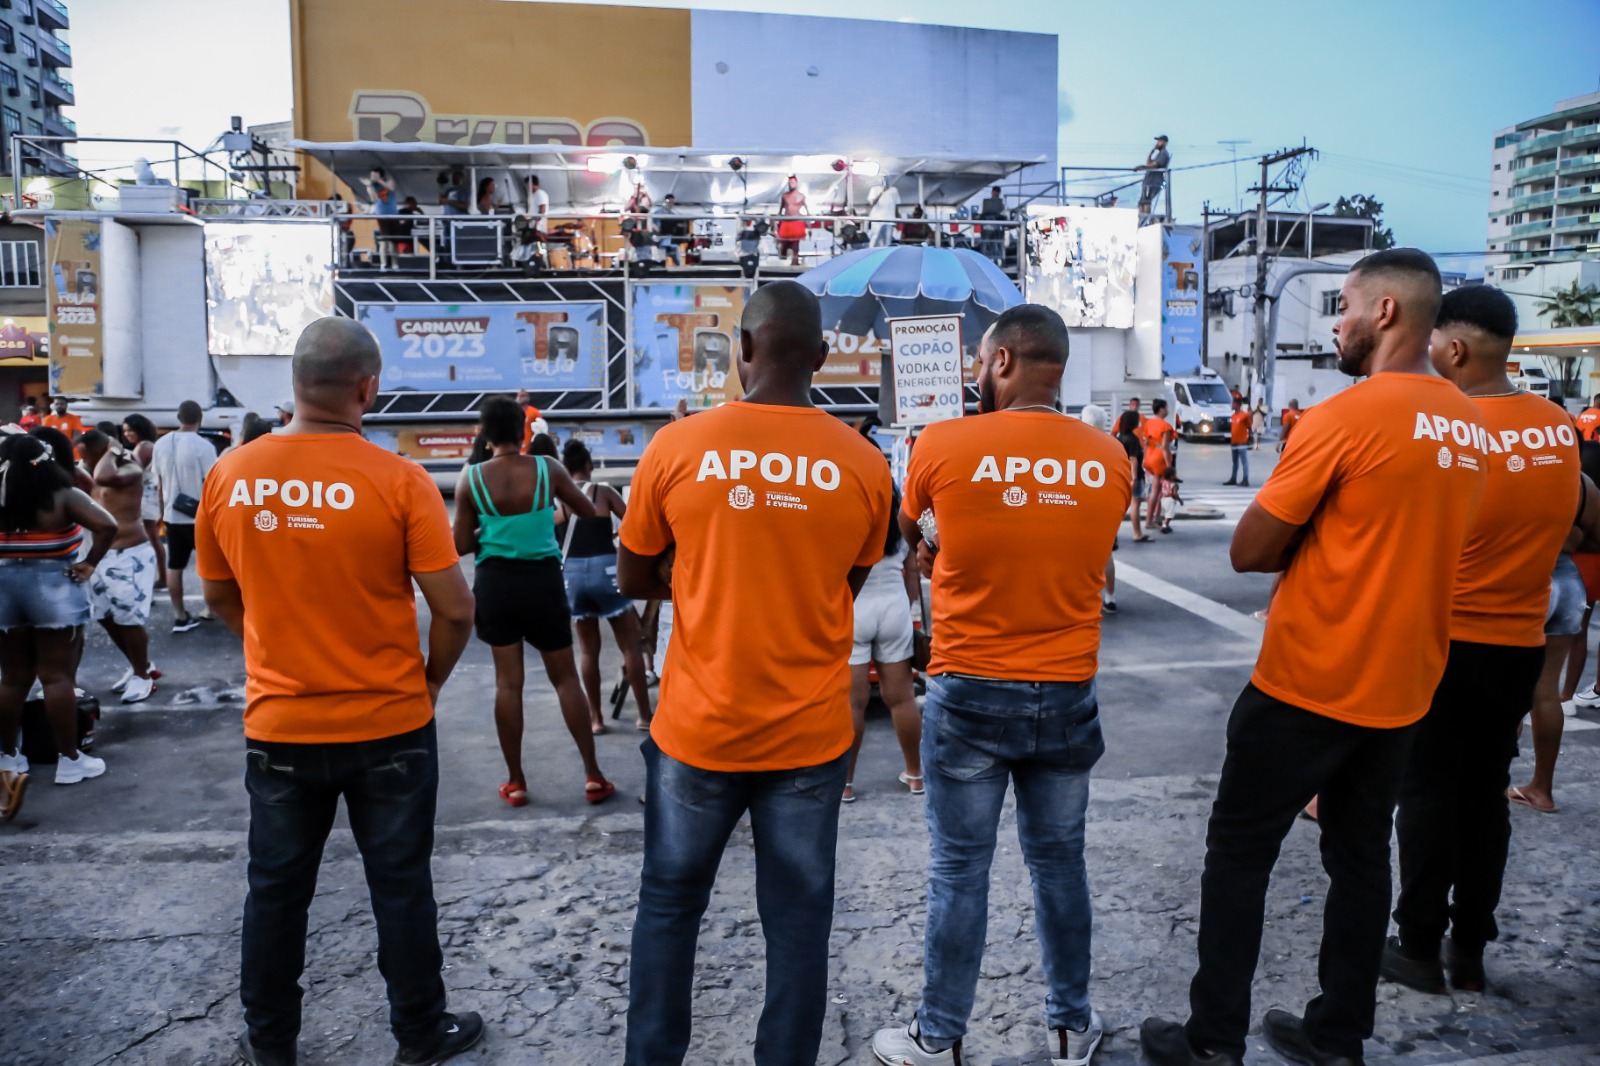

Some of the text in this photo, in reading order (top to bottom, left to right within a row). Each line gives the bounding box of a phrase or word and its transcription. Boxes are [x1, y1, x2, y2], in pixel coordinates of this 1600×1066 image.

[57, 312, 96, 324] 2023
[1168, 307, 1197, 316] 2023
[401, 321, 484, 334] CARNAVAL
[895, 321, 956, 335] PROMOÇÃO
[403, 333, 486, 358] 2023
[899, 339, 954, 357] COPÃO
[897, 362, 940, 375] VODKA
[944, 360, 958, 373] C/
[897, 375, 960, 388] ENERGÉTICO
[1413, 411, 1488, 455] APOIO
[696, 449, 841, 491] APOIO
[971, 455, 1106, 488] APOIO
[228, 478, 355, 510] APOIO
[766, 493, 801, 503] TURISMO
[773, 501, 808, 510] EVENTOS
[294, 522, 325, 530] EVENTOS
